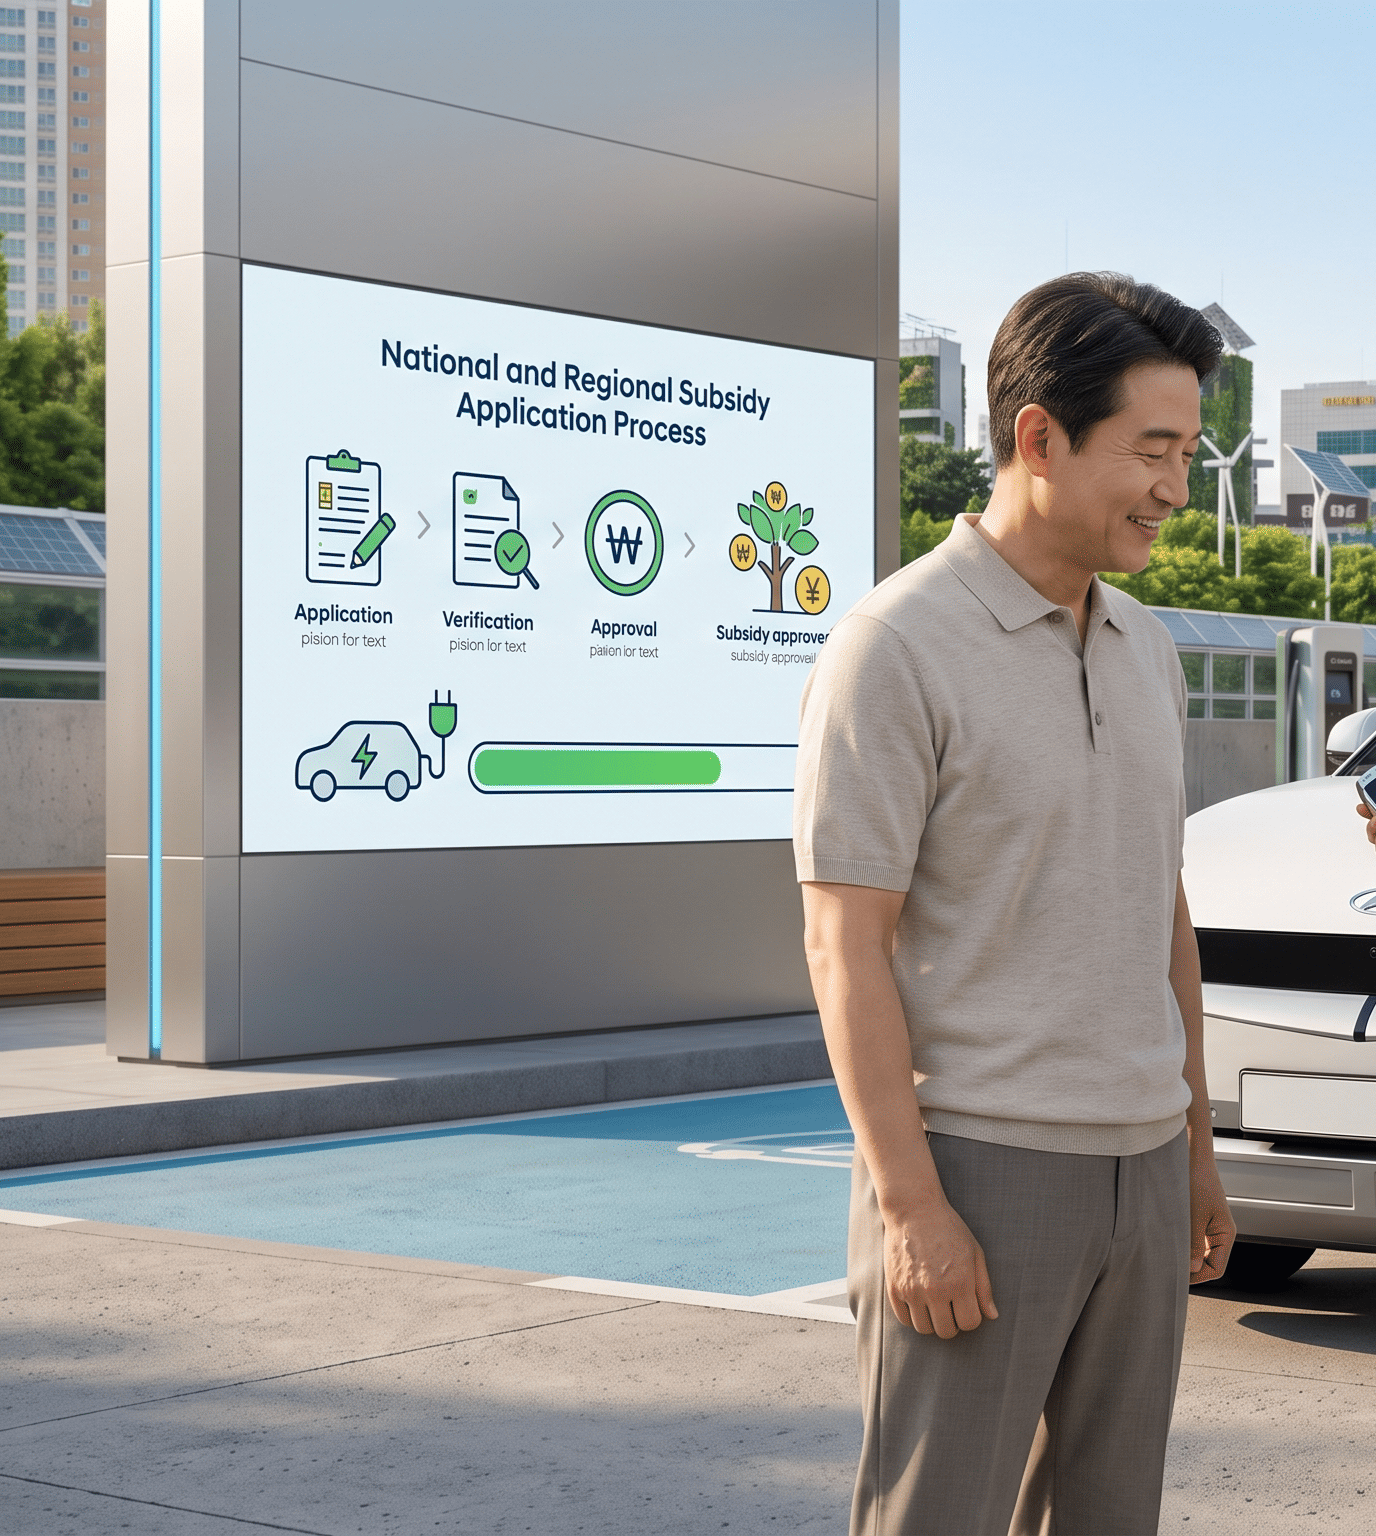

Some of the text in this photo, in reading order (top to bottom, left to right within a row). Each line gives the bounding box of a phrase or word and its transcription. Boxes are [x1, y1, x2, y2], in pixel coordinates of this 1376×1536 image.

[382, 339, 771, 421] National and Regional Subsidy
[456, 391, 707, 446] Application Process
[294, 603, 393, 625] Application
[442, 610, 534, 631] Verification
[591, 618, 657, 639] Approval
[716, 624, 770, 645] Subsidy
[301, 631, 387, 648] pision for text
[449, 637, 485, 653] pision
[504, 640, 527, 653] text
[638, 646, 659, 658] text
[730, 649, 769, 665] subsidy
